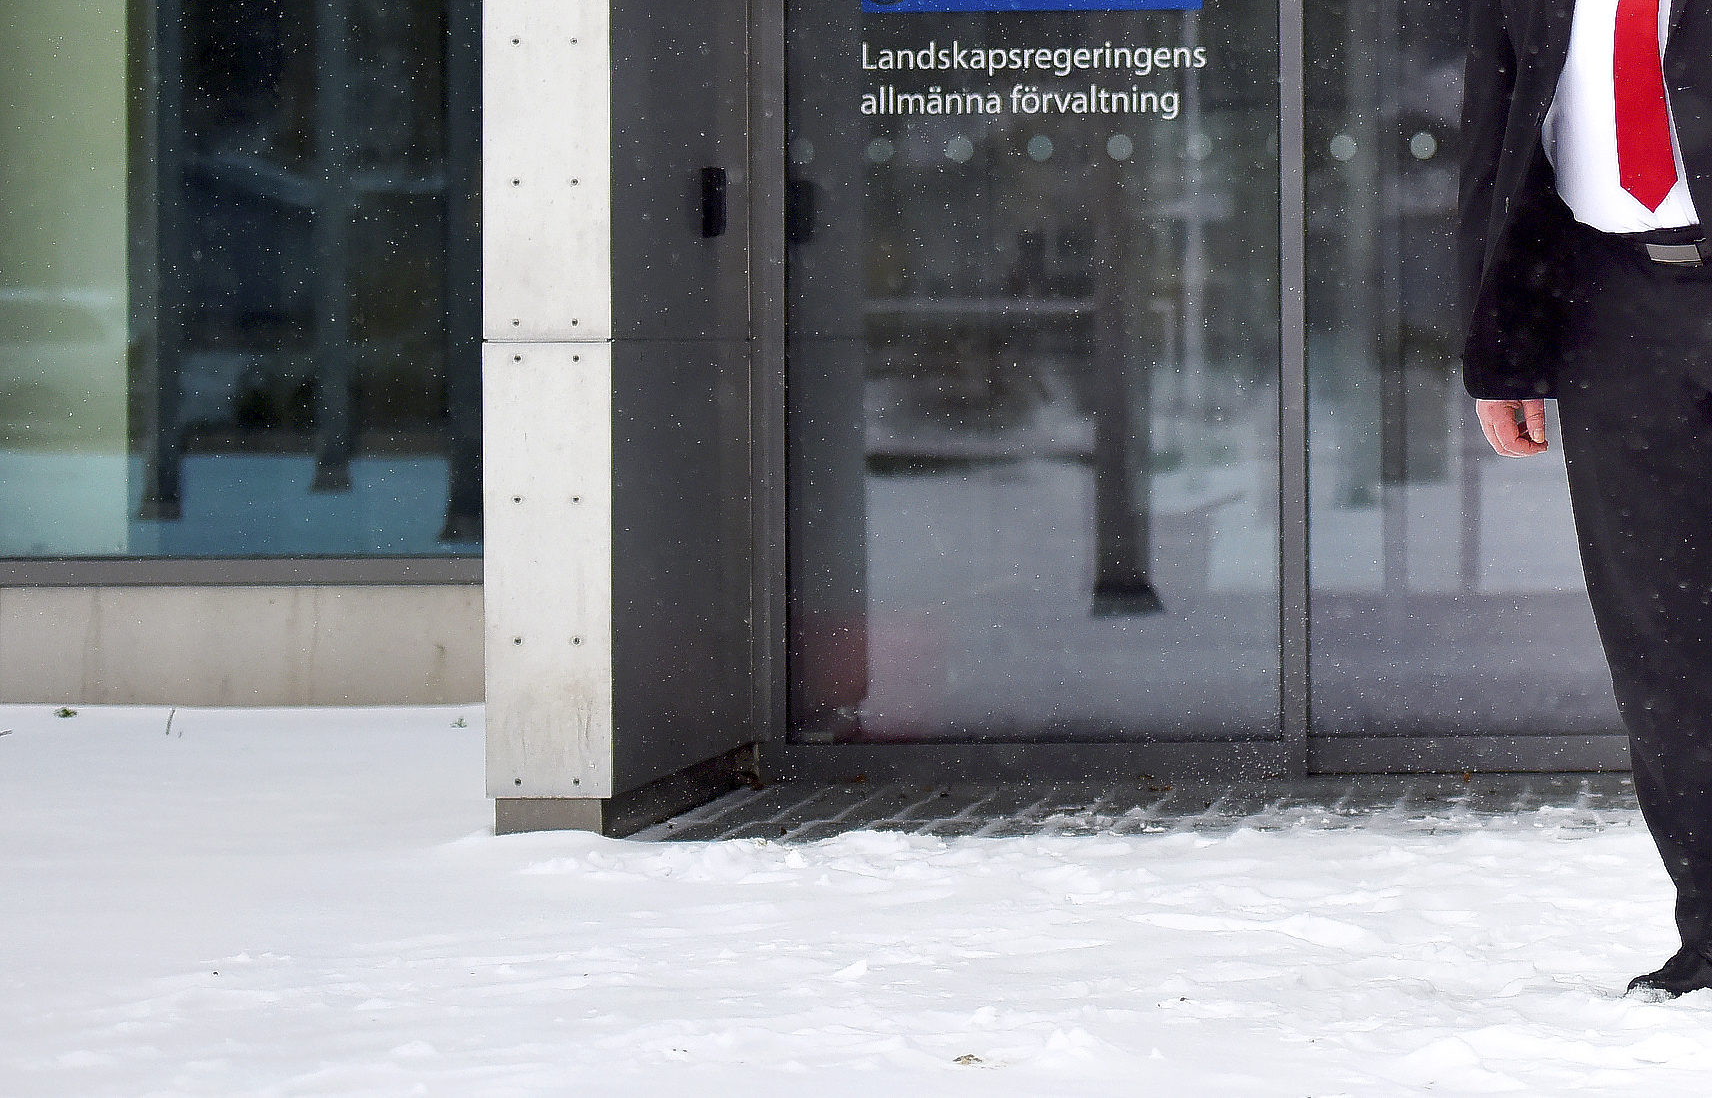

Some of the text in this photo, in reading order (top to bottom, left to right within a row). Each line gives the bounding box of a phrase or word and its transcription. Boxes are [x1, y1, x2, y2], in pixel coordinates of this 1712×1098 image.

[862, 40, 1207, 76] Landskapsregeringens
[860, 84, 1180, 119] allmänna förvaltning
